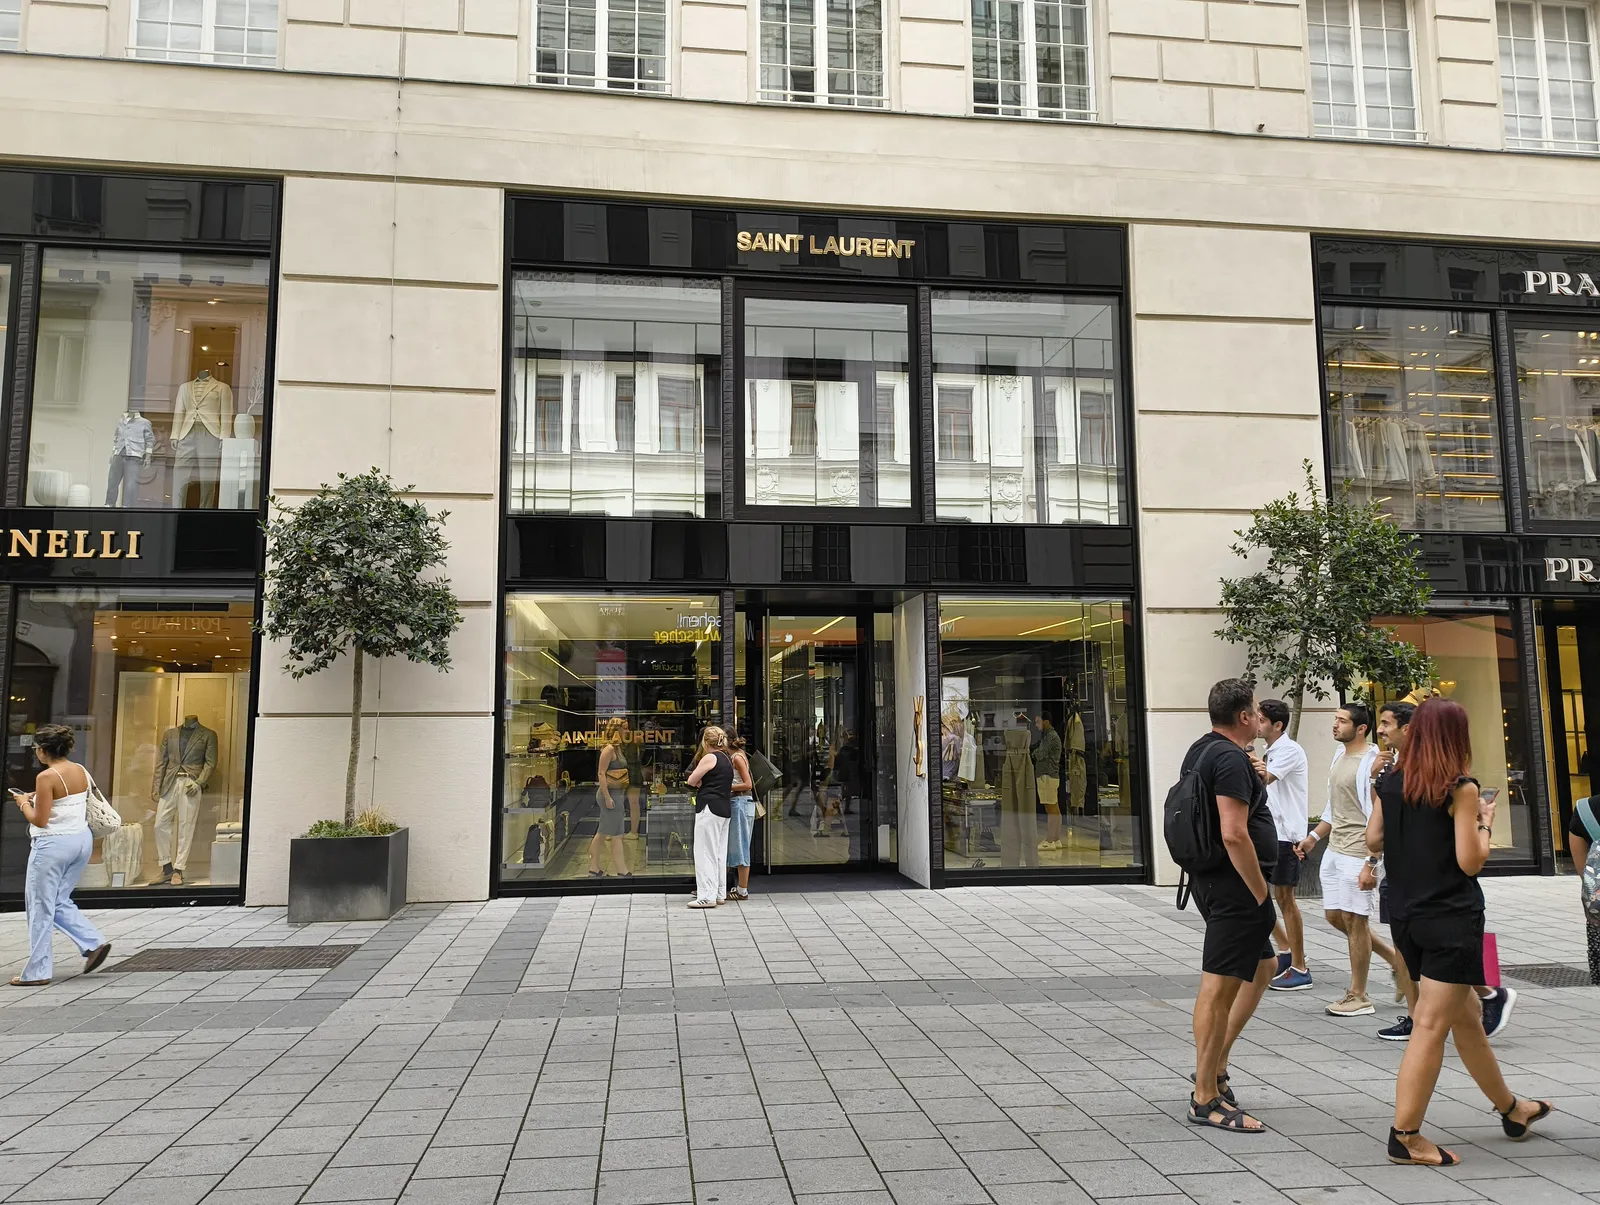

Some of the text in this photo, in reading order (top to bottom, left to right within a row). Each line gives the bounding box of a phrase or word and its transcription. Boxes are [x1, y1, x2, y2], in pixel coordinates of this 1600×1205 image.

[736, 231, 916, 259] SAINT LAURENT
[1522, 270, 1600, 297] PRA
[0, 528, 142, 559] NELLI
[1543, 557, 1600, 583] PR
[551, 730, 675, 744] SAINT LAURENT
